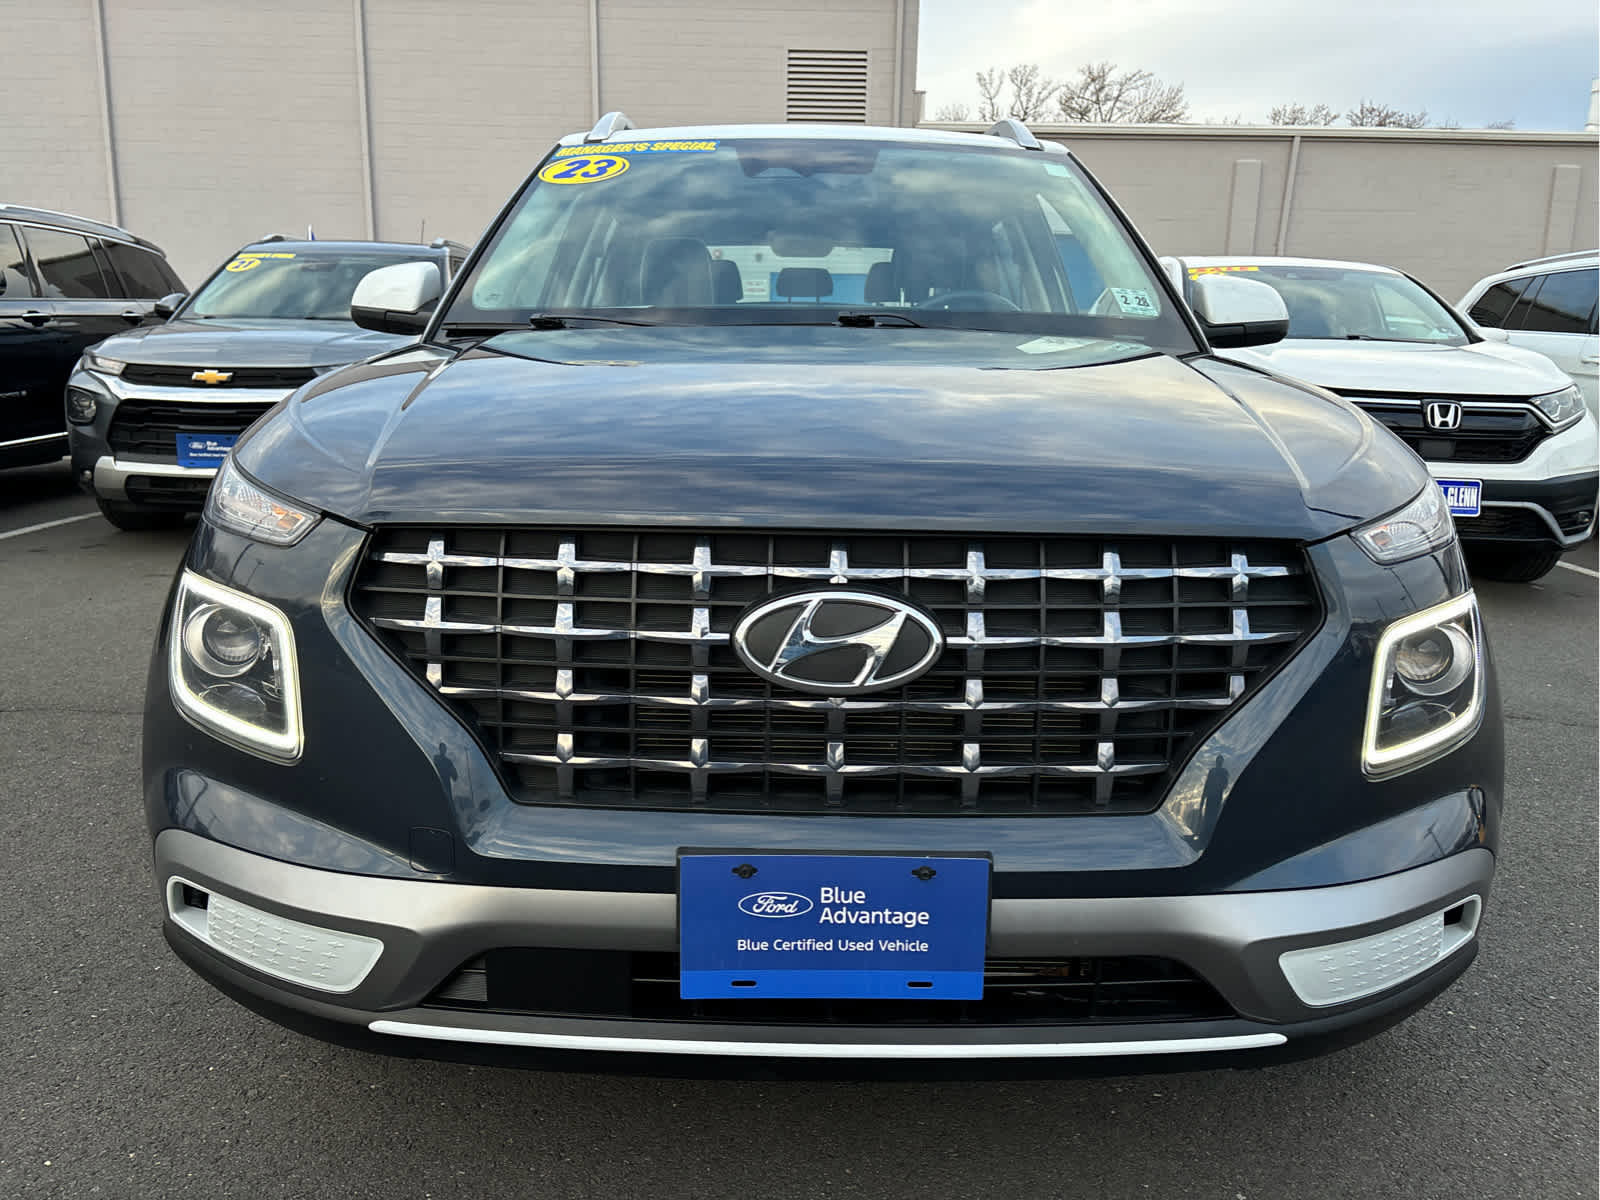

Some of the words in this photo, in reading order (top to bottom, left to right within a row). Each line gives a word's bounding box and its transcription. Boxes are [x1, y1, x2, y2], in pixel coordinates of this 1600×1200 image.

[650, 141, 717, 151] SPECIAL
[553, 159, 617, 179] 23
[1120, 295, 1130, 305] 2
[1447, 487, 1478, 507] GLENN
[752, 893, 799, 914] Ford
[819, 887, 866, 904] Blue
[819, 907, 930, 928] Advantage
[737, 939, 769, 951] Blue
[773, 939, 833, 952] Certified
[838, 939, 874, 952] Used
[879, 940, 929, 952] Vehicle
